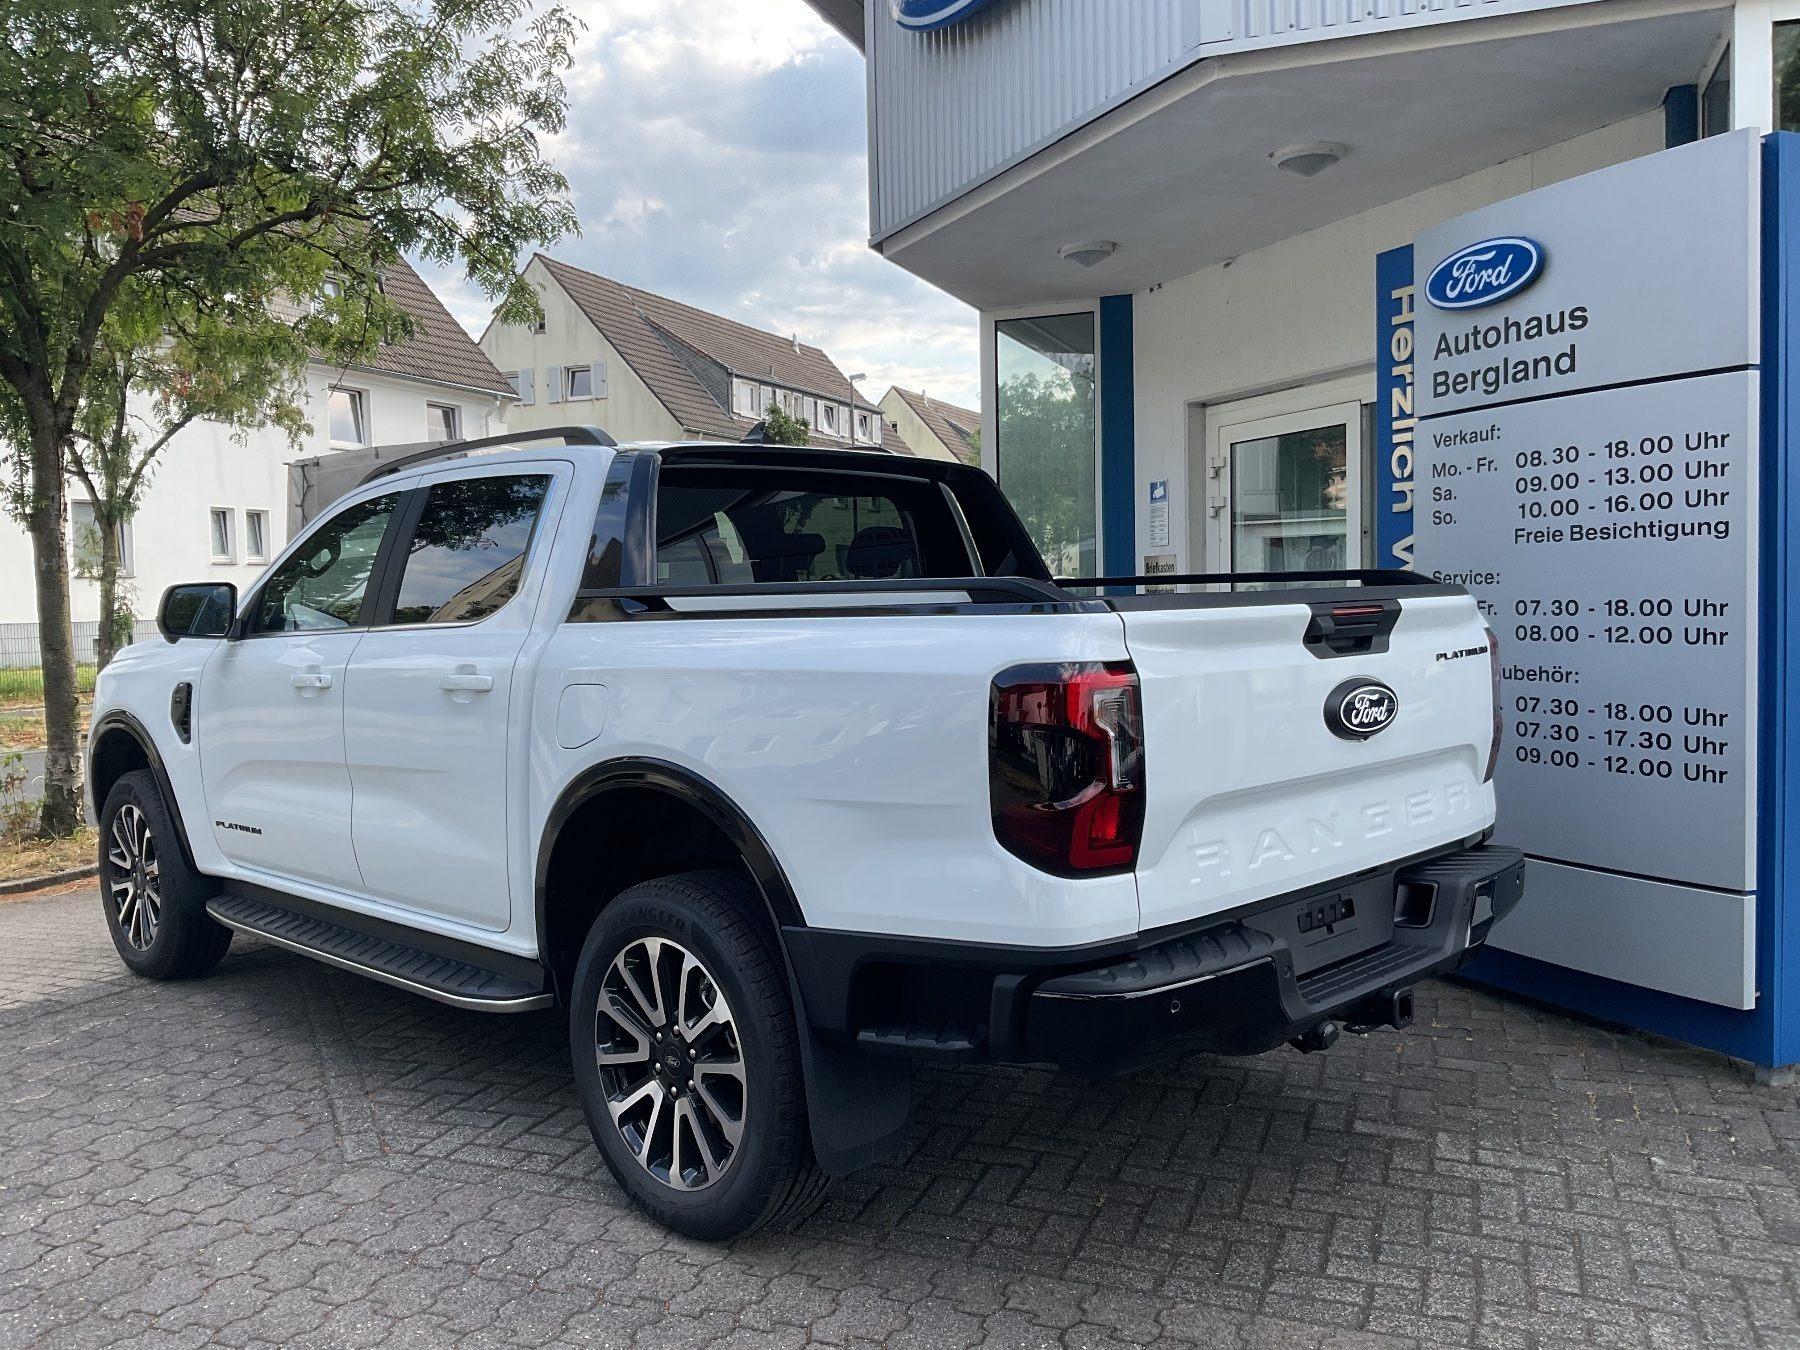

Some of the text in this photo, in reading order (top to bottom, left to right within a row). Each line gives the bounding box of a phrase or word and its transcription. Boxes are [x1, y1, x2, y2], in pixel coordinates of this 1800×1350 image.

[1446, 250, 1513, 298] Ford
[1433, 306, 1588, 360] Autohaus
[1433, 344, 1576, 398] Bergland
[1433, 424, 1500, 448] Verkauf:
[1432, 462, 1461, 478] Mo.
[1477, 457, 1497, 473] Fr.
[1515, 446, 1580, 468] 08.30
[1604, 435, 1673, 458] 18.00
[1685, 432, 1729, 451] Uhr
[1432, 487, 1457, 502] Sa.
[1515, 472, 1580, 493] 09.00
[1604, 463, 1673, 486] 13.00
[1685, 460, 1729, 479] Uhr
[1432, 510, 1457, 525] So.
[1518, 499, 1579, 519] 10.00
[1604, 491, 1673, 513] 16.00
[1684, 489, 1729, 508] Uhr
[1514, 520, 1729, 544] Freie Besichtigung
[1433, 570, 1500, 585] Service:
[1515, 599, 1579, 616] 07.30
[1604, 599, 1672, 616] 18.00
[1684, 599, 1729, 616] Uhr
[1515, 625, 1579, 642] 08.00
[1604, 626, 1672, 644] 12.00
[1684, 627, 1729, 645] Uhr
[1436, 645, 1488, 661] PLATINUM
[1500, 665, 1579, 684] ubehör:
[1351, 693, 1388, 725] Ford
[1515, 696, 1579, 717] 07.30
[1604, 703, 1672, 723] 18.00
[1684, 707, 1728, 727] Uhr
[1515, 721, 1579, 742] 07.30
[1604, 729, 1672, 751] 17.30
[1684, 735, 1728, 755] Uhr
[1516, 746, 1579, 768] 09.00
[1604, 756, 1672, 778] 12.00
[1684, 763, 1728, 784] Uhr
[215, 820, 262, 835] PLATINUM
[1188, 781, 1471, 884] RANGER
